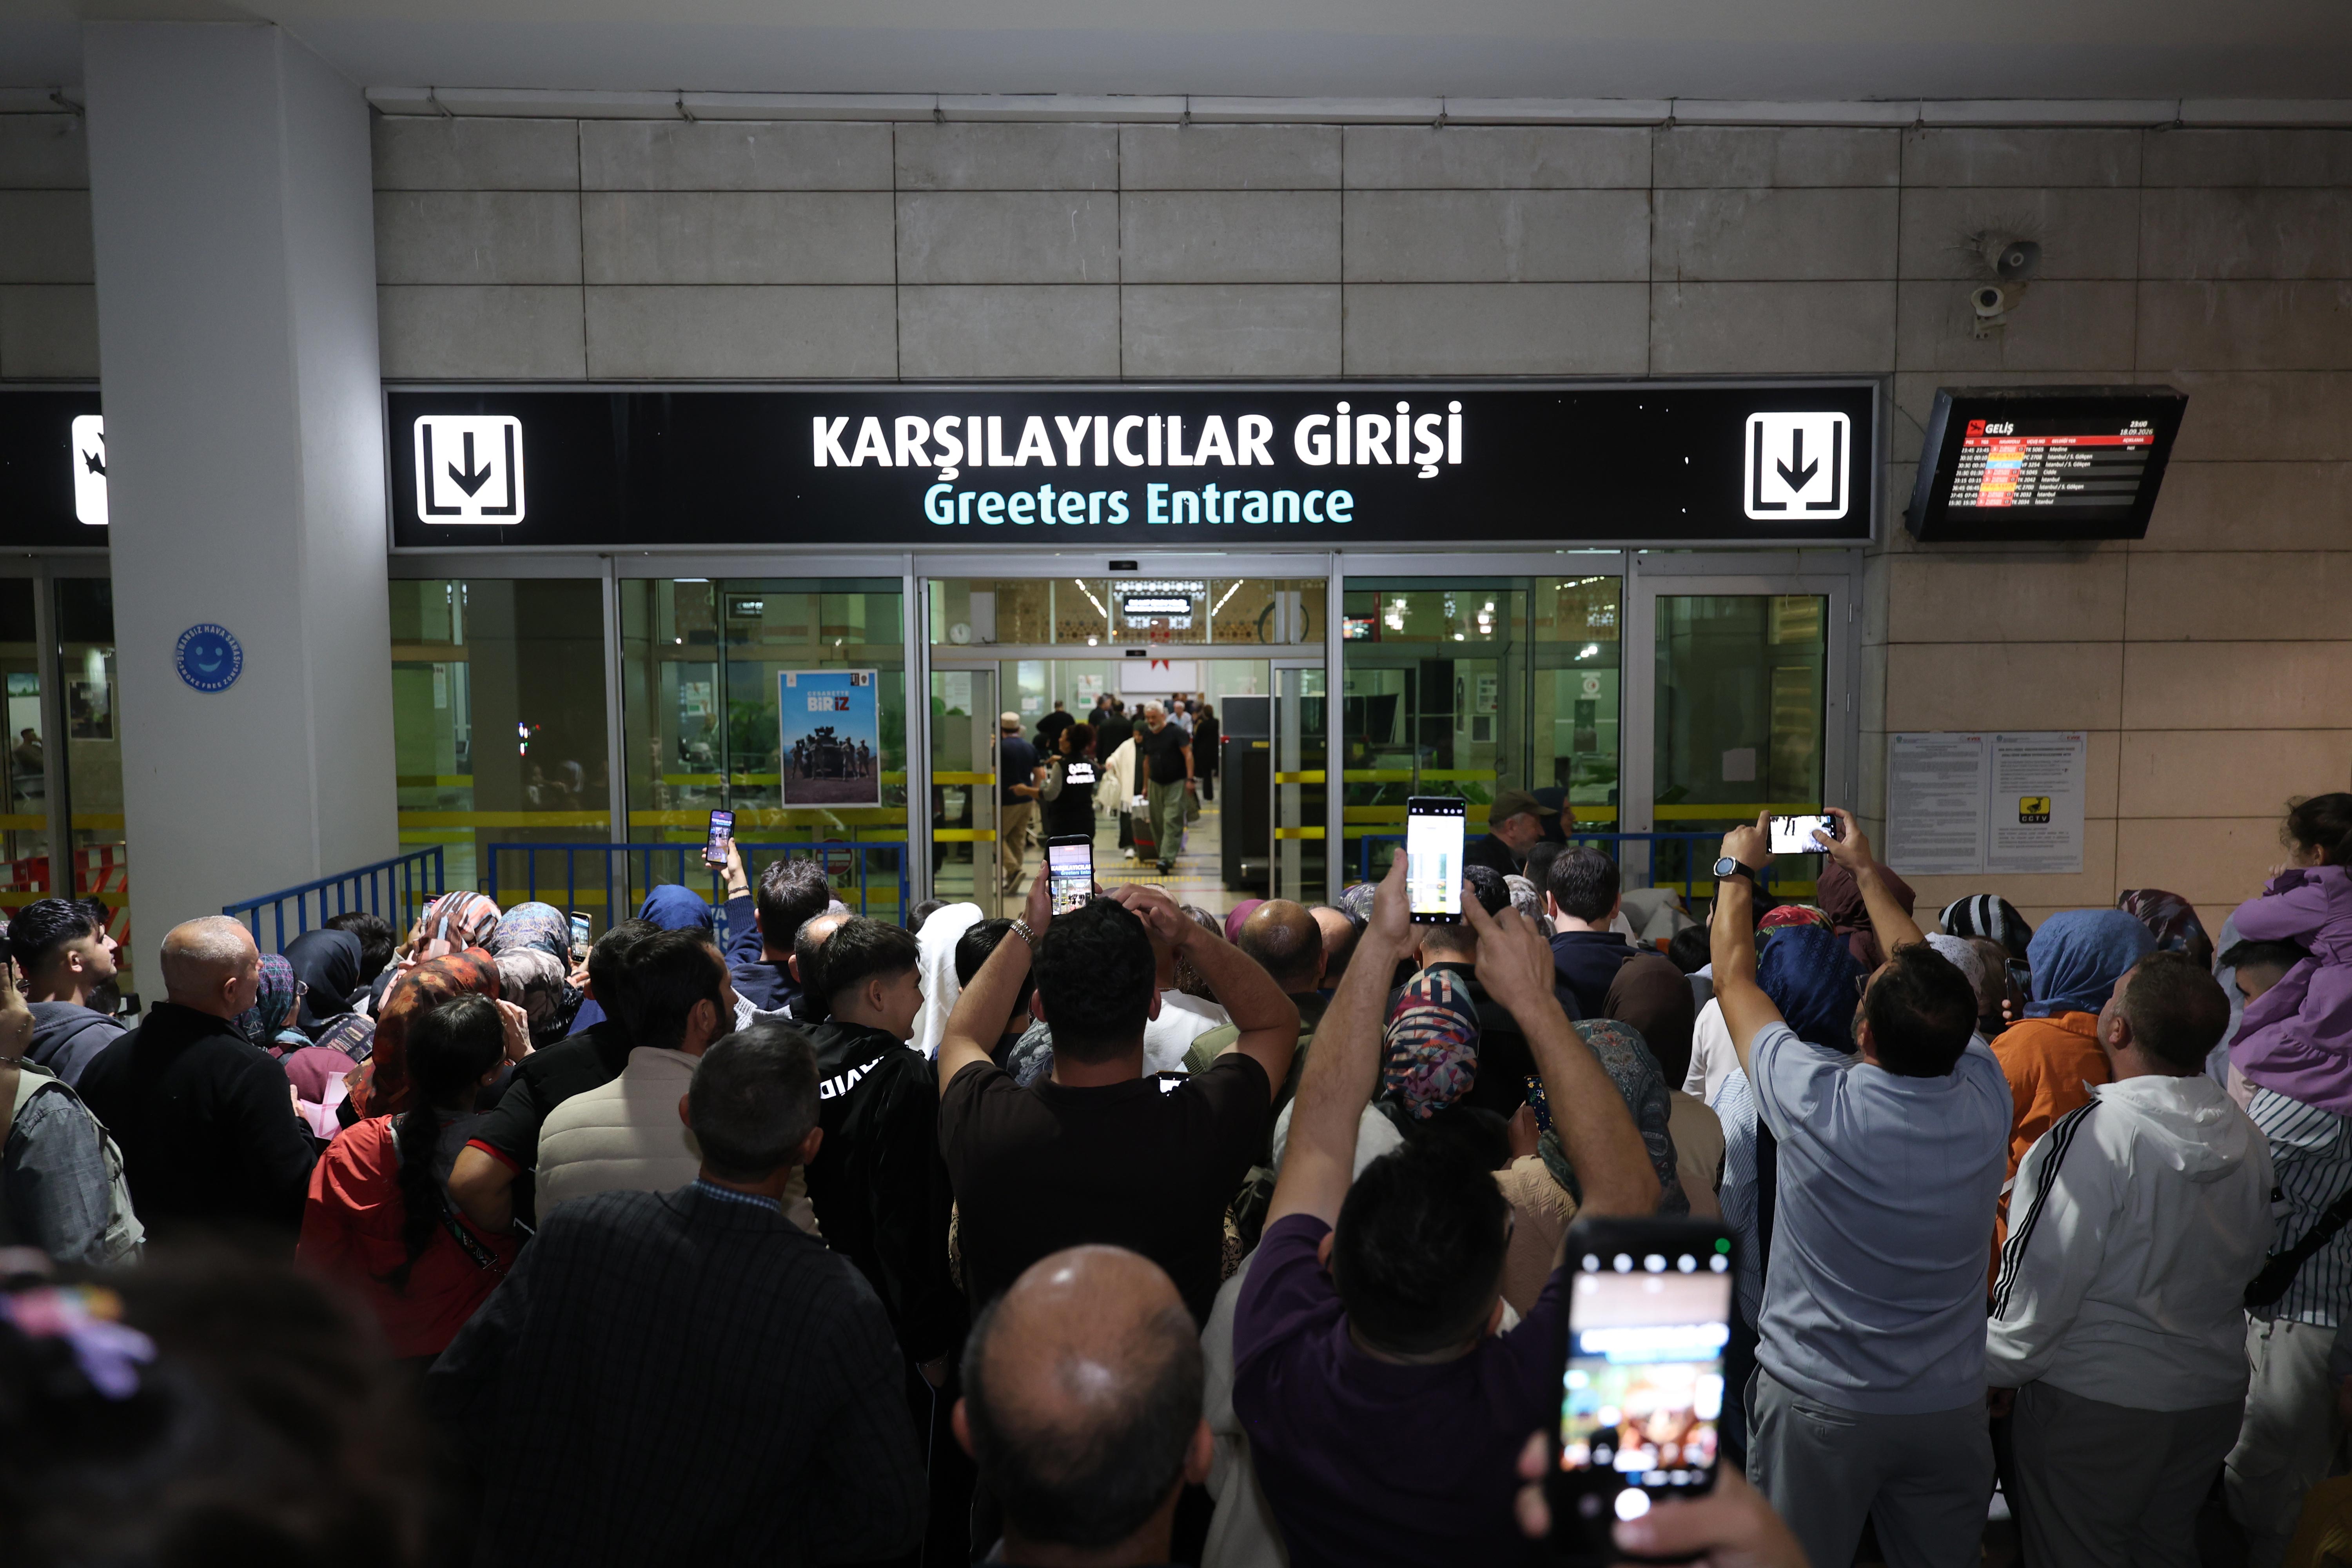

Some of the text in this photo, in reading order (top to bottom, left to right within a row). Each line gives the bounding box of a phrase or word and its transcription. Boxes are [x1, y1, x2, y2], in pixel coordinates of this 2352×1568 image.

[813, 401, 1463, 481] KARŞILAYICILAR GİRİŞİ
[1985, 421, 2014, 436] GELİŞ
[924, 481, 1354, 525] Greeters Entrance
[205, 626, 226, 637] HAVA
